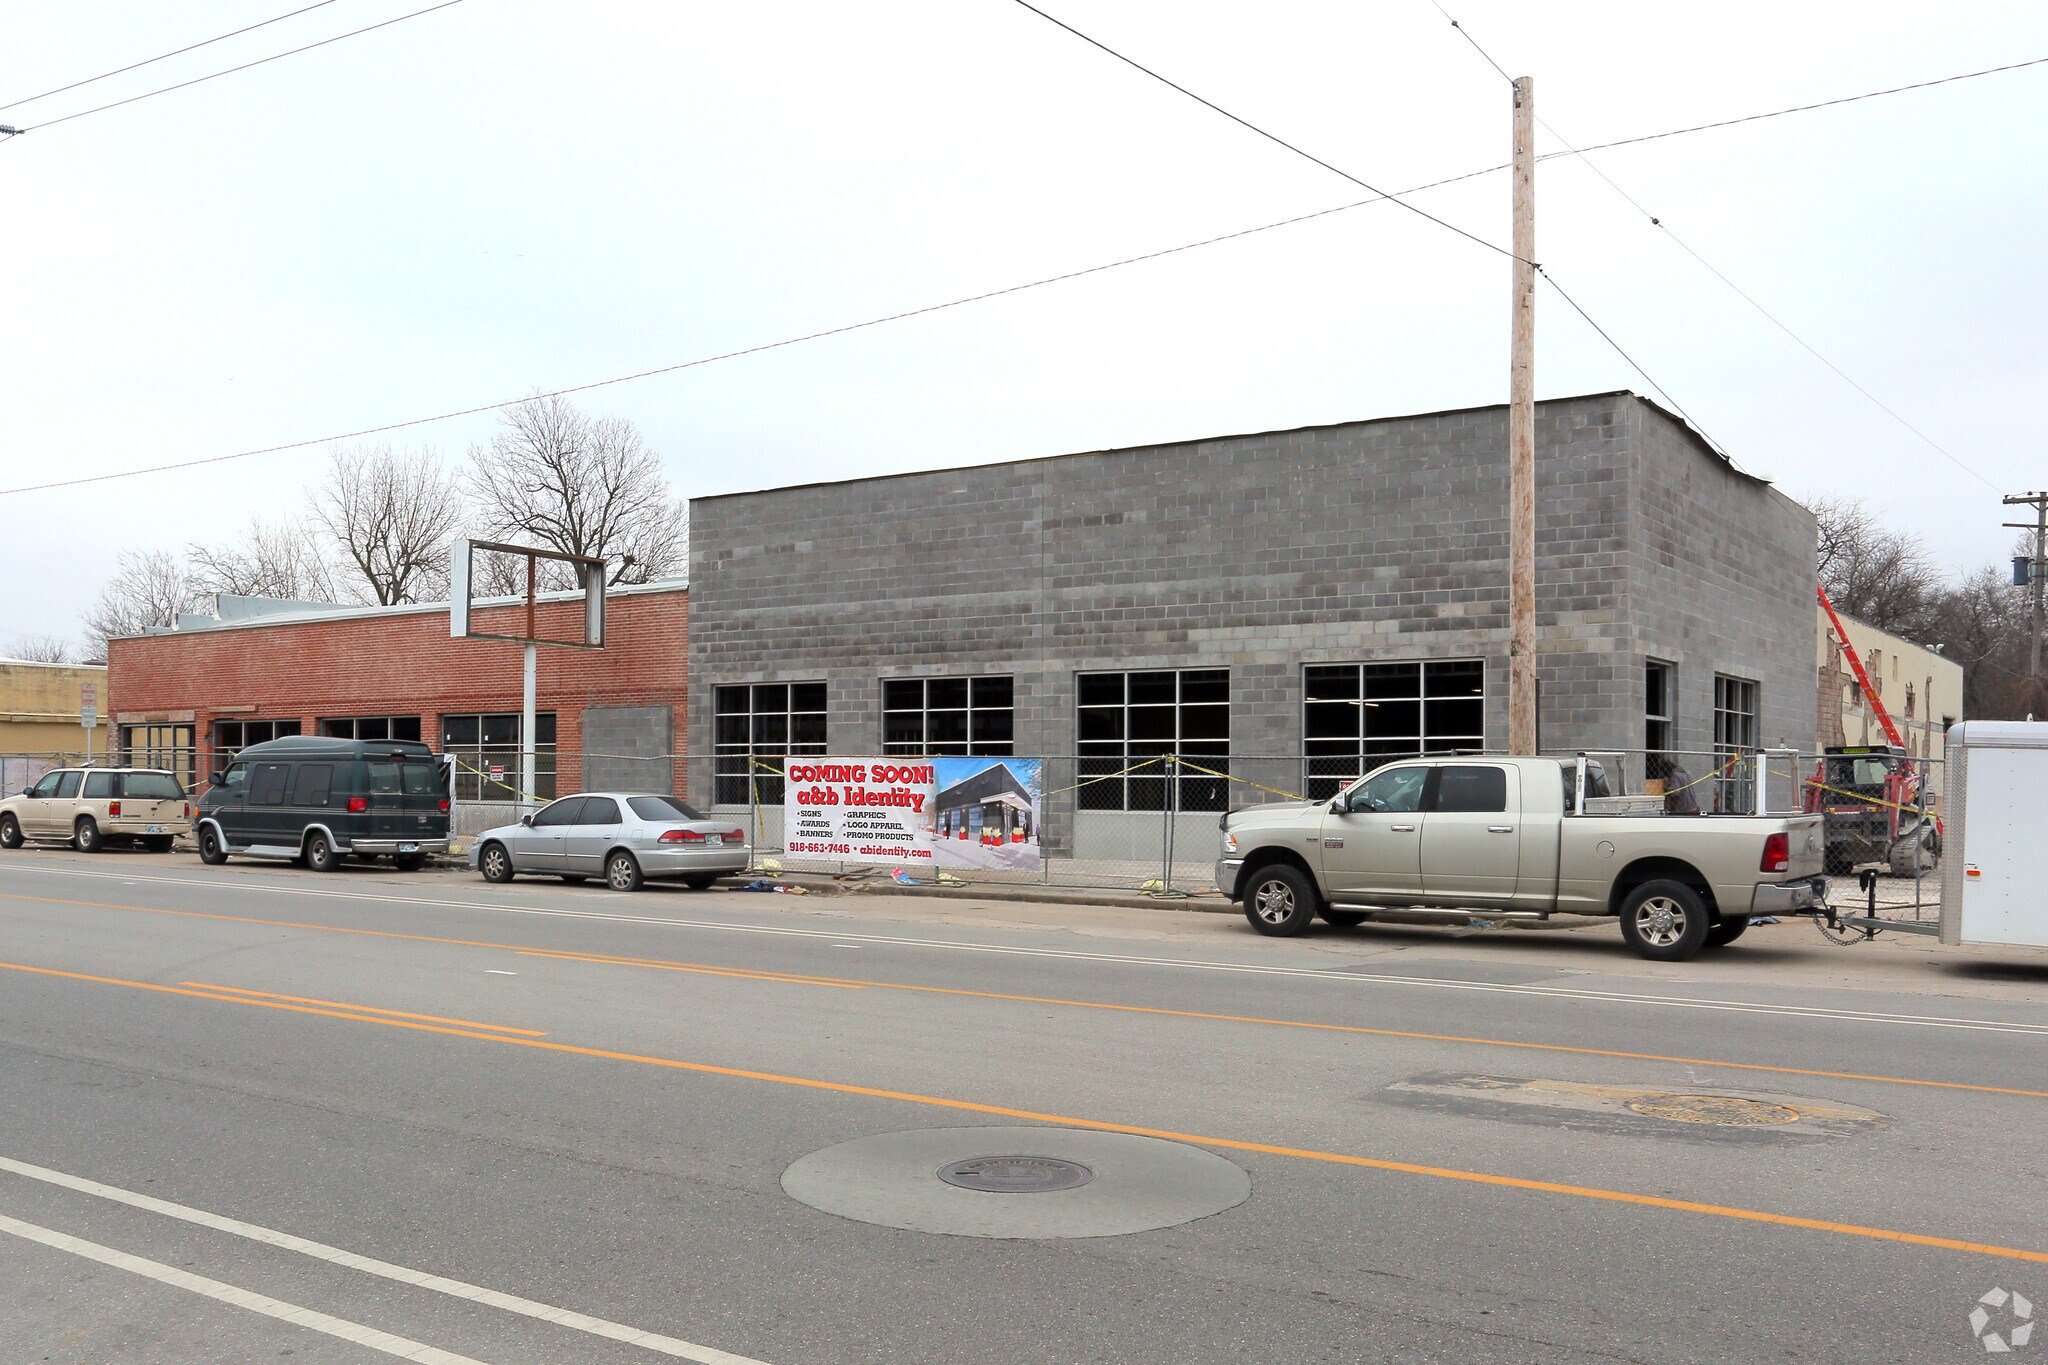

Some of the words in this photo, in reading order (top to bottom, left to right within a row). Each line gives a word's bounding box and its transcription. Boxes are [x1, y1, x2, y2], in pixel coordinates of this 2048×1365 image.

[790, 765, 867, 782] COMING
[871, 765, 934, 784] SOON!
[797, 785, 839, 806] a&b
[843, 786, 926, 813] Identity
[846, 811, 887, 819] GRAPHICS
[800, 820, 830, 828] AWARDS
[847, 821, 869, 829] LOGO
[869, 822, 904, 830] APPAREL
[800, 830, 834, 838] BANNERS
[846, 831, 874, 840] PROMO
[874, 832, 914, 841] PRODUCTS
[859, 845, 932, 859] abidentity.com
